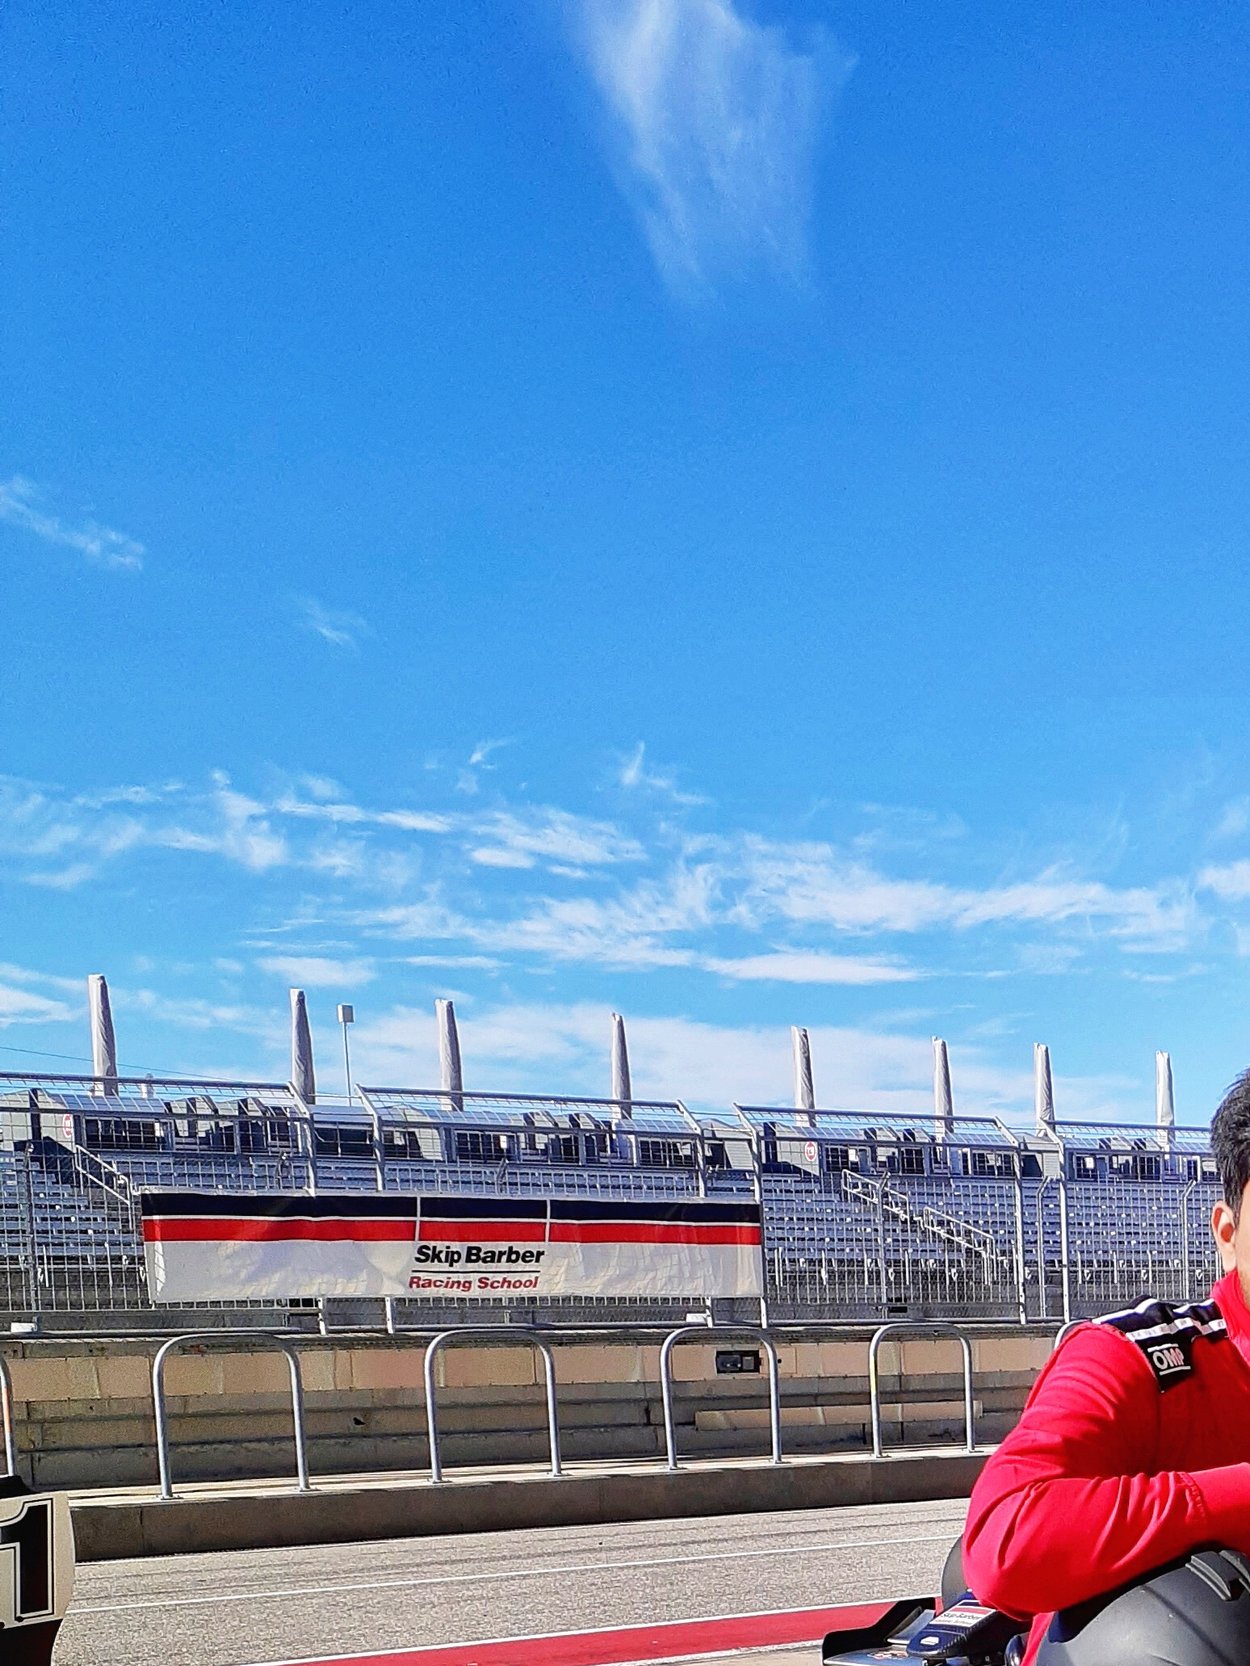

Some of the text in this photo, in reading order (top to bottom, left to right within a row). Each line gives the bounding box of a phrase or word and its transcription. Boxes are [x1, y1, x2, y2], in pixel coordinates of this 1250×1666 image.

[414, 1244, 546, 1268] Skip Barber
[408, 1275, 539, 1292] Racing School
